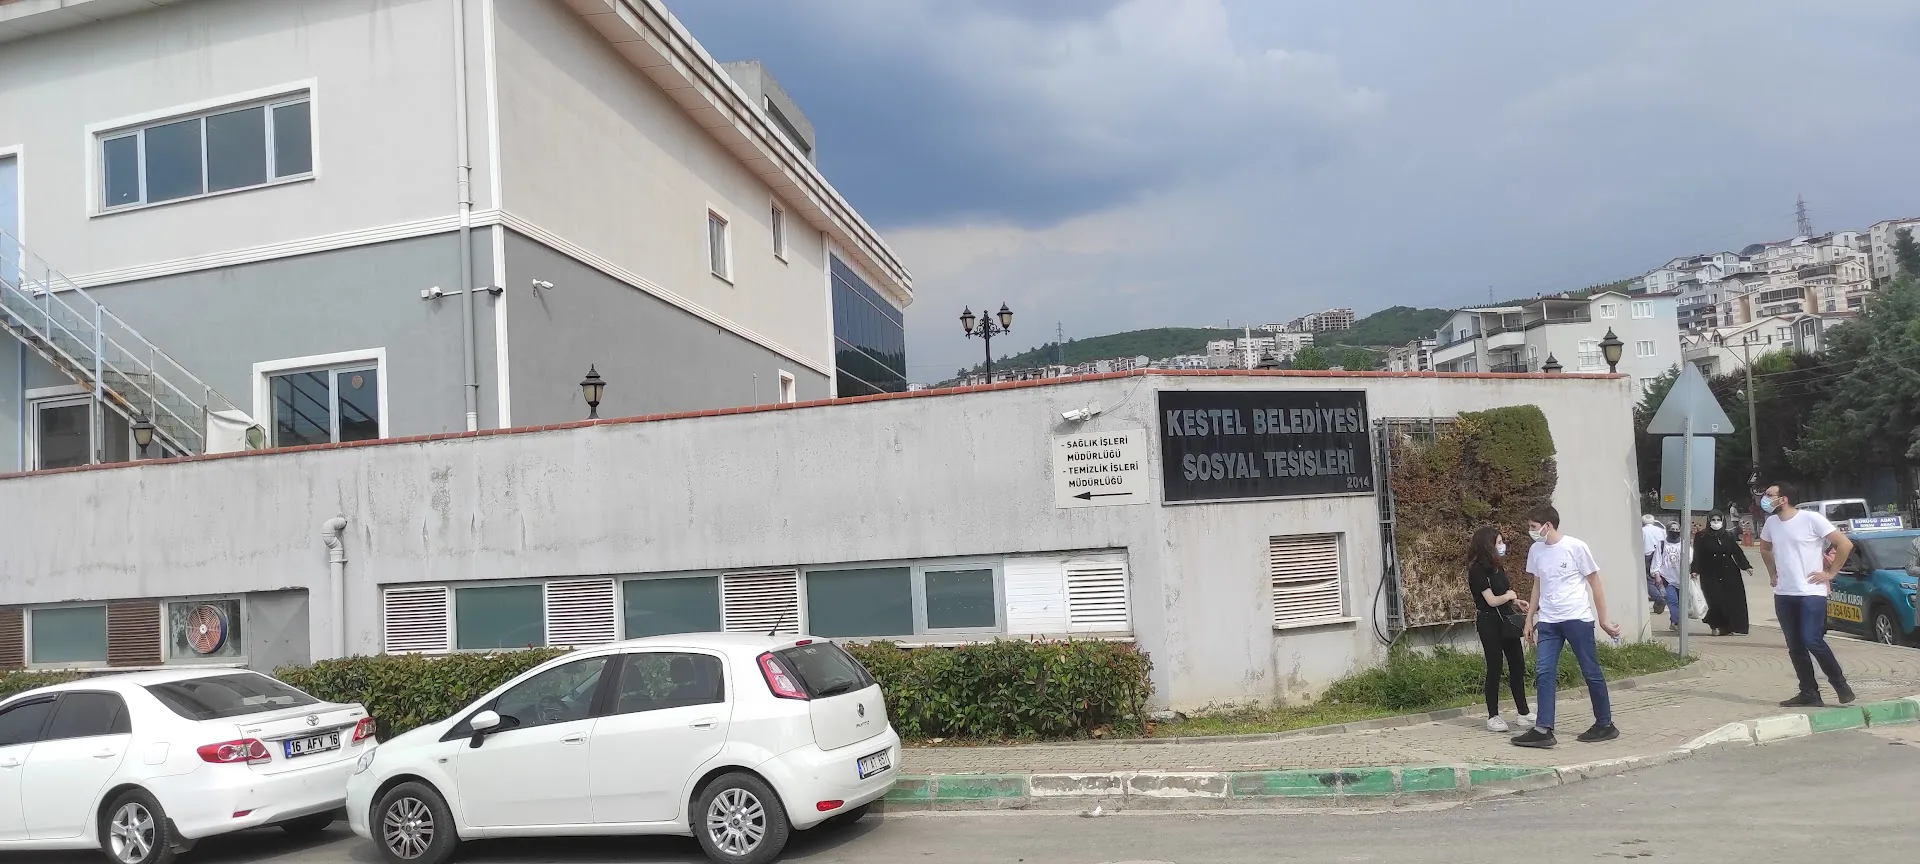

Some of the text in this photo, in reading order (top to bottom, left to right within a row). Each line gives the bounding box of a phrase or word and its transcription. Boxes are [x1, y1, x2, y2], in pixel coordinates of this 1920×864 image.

[1166, 401, 1365, 436] KESTEL BELEDİYESİ
[1066, 438, 1098, 448] SAĞLIK
[1100, 435, 1128, 447] İŞLERİ
[1067, 449, 1121, 461] MÜDÜRLÜĞÜ
[1069, 463, 1109, 475] TEMİZLİK
[1110, 461, 1139, 472] İŞLERİ
[1183, 451, 1260, 481] SOSYAL
[1069, 475, 1123, 487] MÜDÜRLÜĞÜ
[1346, 476, 1370, 488] 2014
[291, 741, 301, 753] 16
[307, 736, 323, 750] AFV
[329, 734, 338, 745] 16
